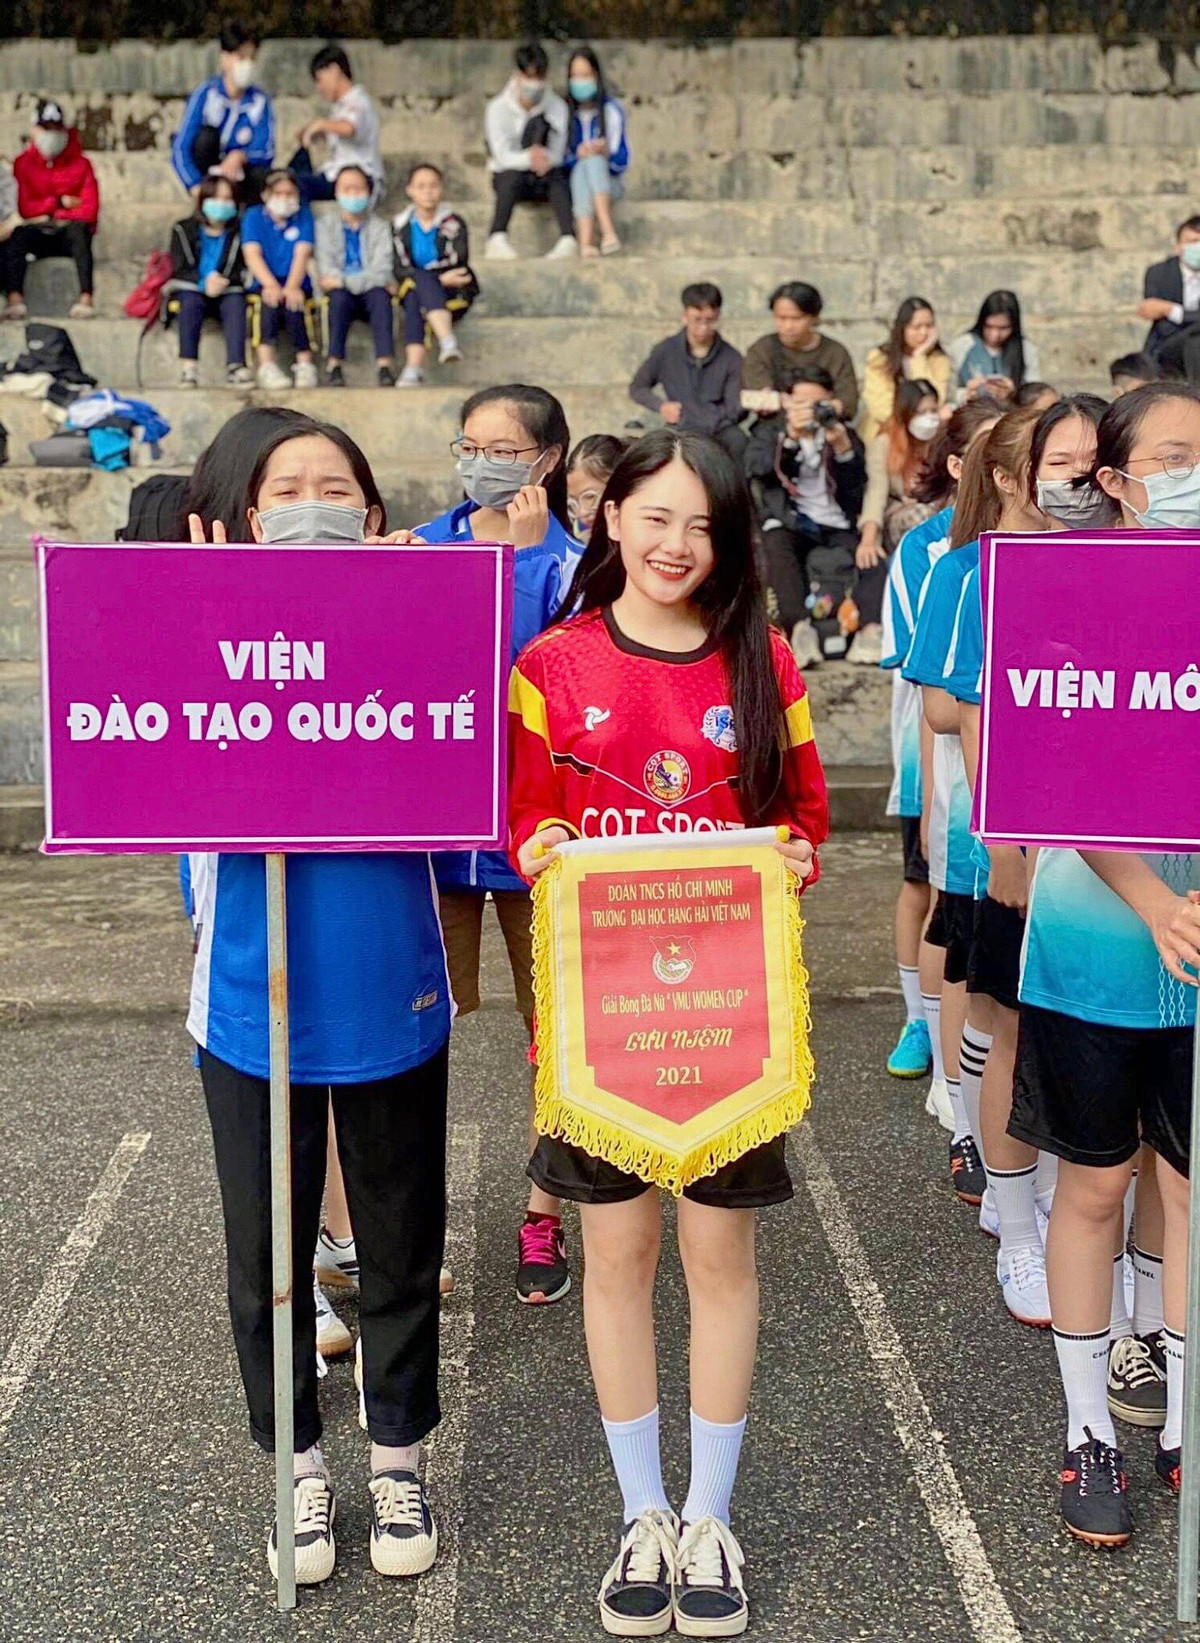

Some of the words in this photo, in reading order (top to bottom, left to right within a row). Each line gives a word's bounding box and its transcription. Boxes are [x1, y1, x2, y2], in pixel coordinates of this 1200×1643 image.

[218, 631, 325, 691] VIỆN
[1006, 661, 1116, 719] VIỆN
[1128, 663, 1200, 712] MÔ
[67, 694, 169, 742] ĐÀO
[182, 702, 273, 751] TẠO
[287, 689, 414, 744] QUỐC
[427, 689, 476, 741] TẾ
[581, 806, 647, 839] COT
[608, 879, 638, 902] ĐOÀN
[639, 883, 665, 901] TNCS
[705, 879, 733, 898] MINH
[630, 909, 646, 929] ĐẠI
[648, 907, 667, 930] HỌC
[694, 900, 710, 923] HẢI
[710, 900, 729, 926] VIỆT
[730, 903, 751, 921] NAM
[619, 994, 640, 1018] Bóng
[692, 989, 725, 1010] WOMEN
[624, 1029, 669, 1052] LƯU
[656, 1065, 704, 1087] 2021
